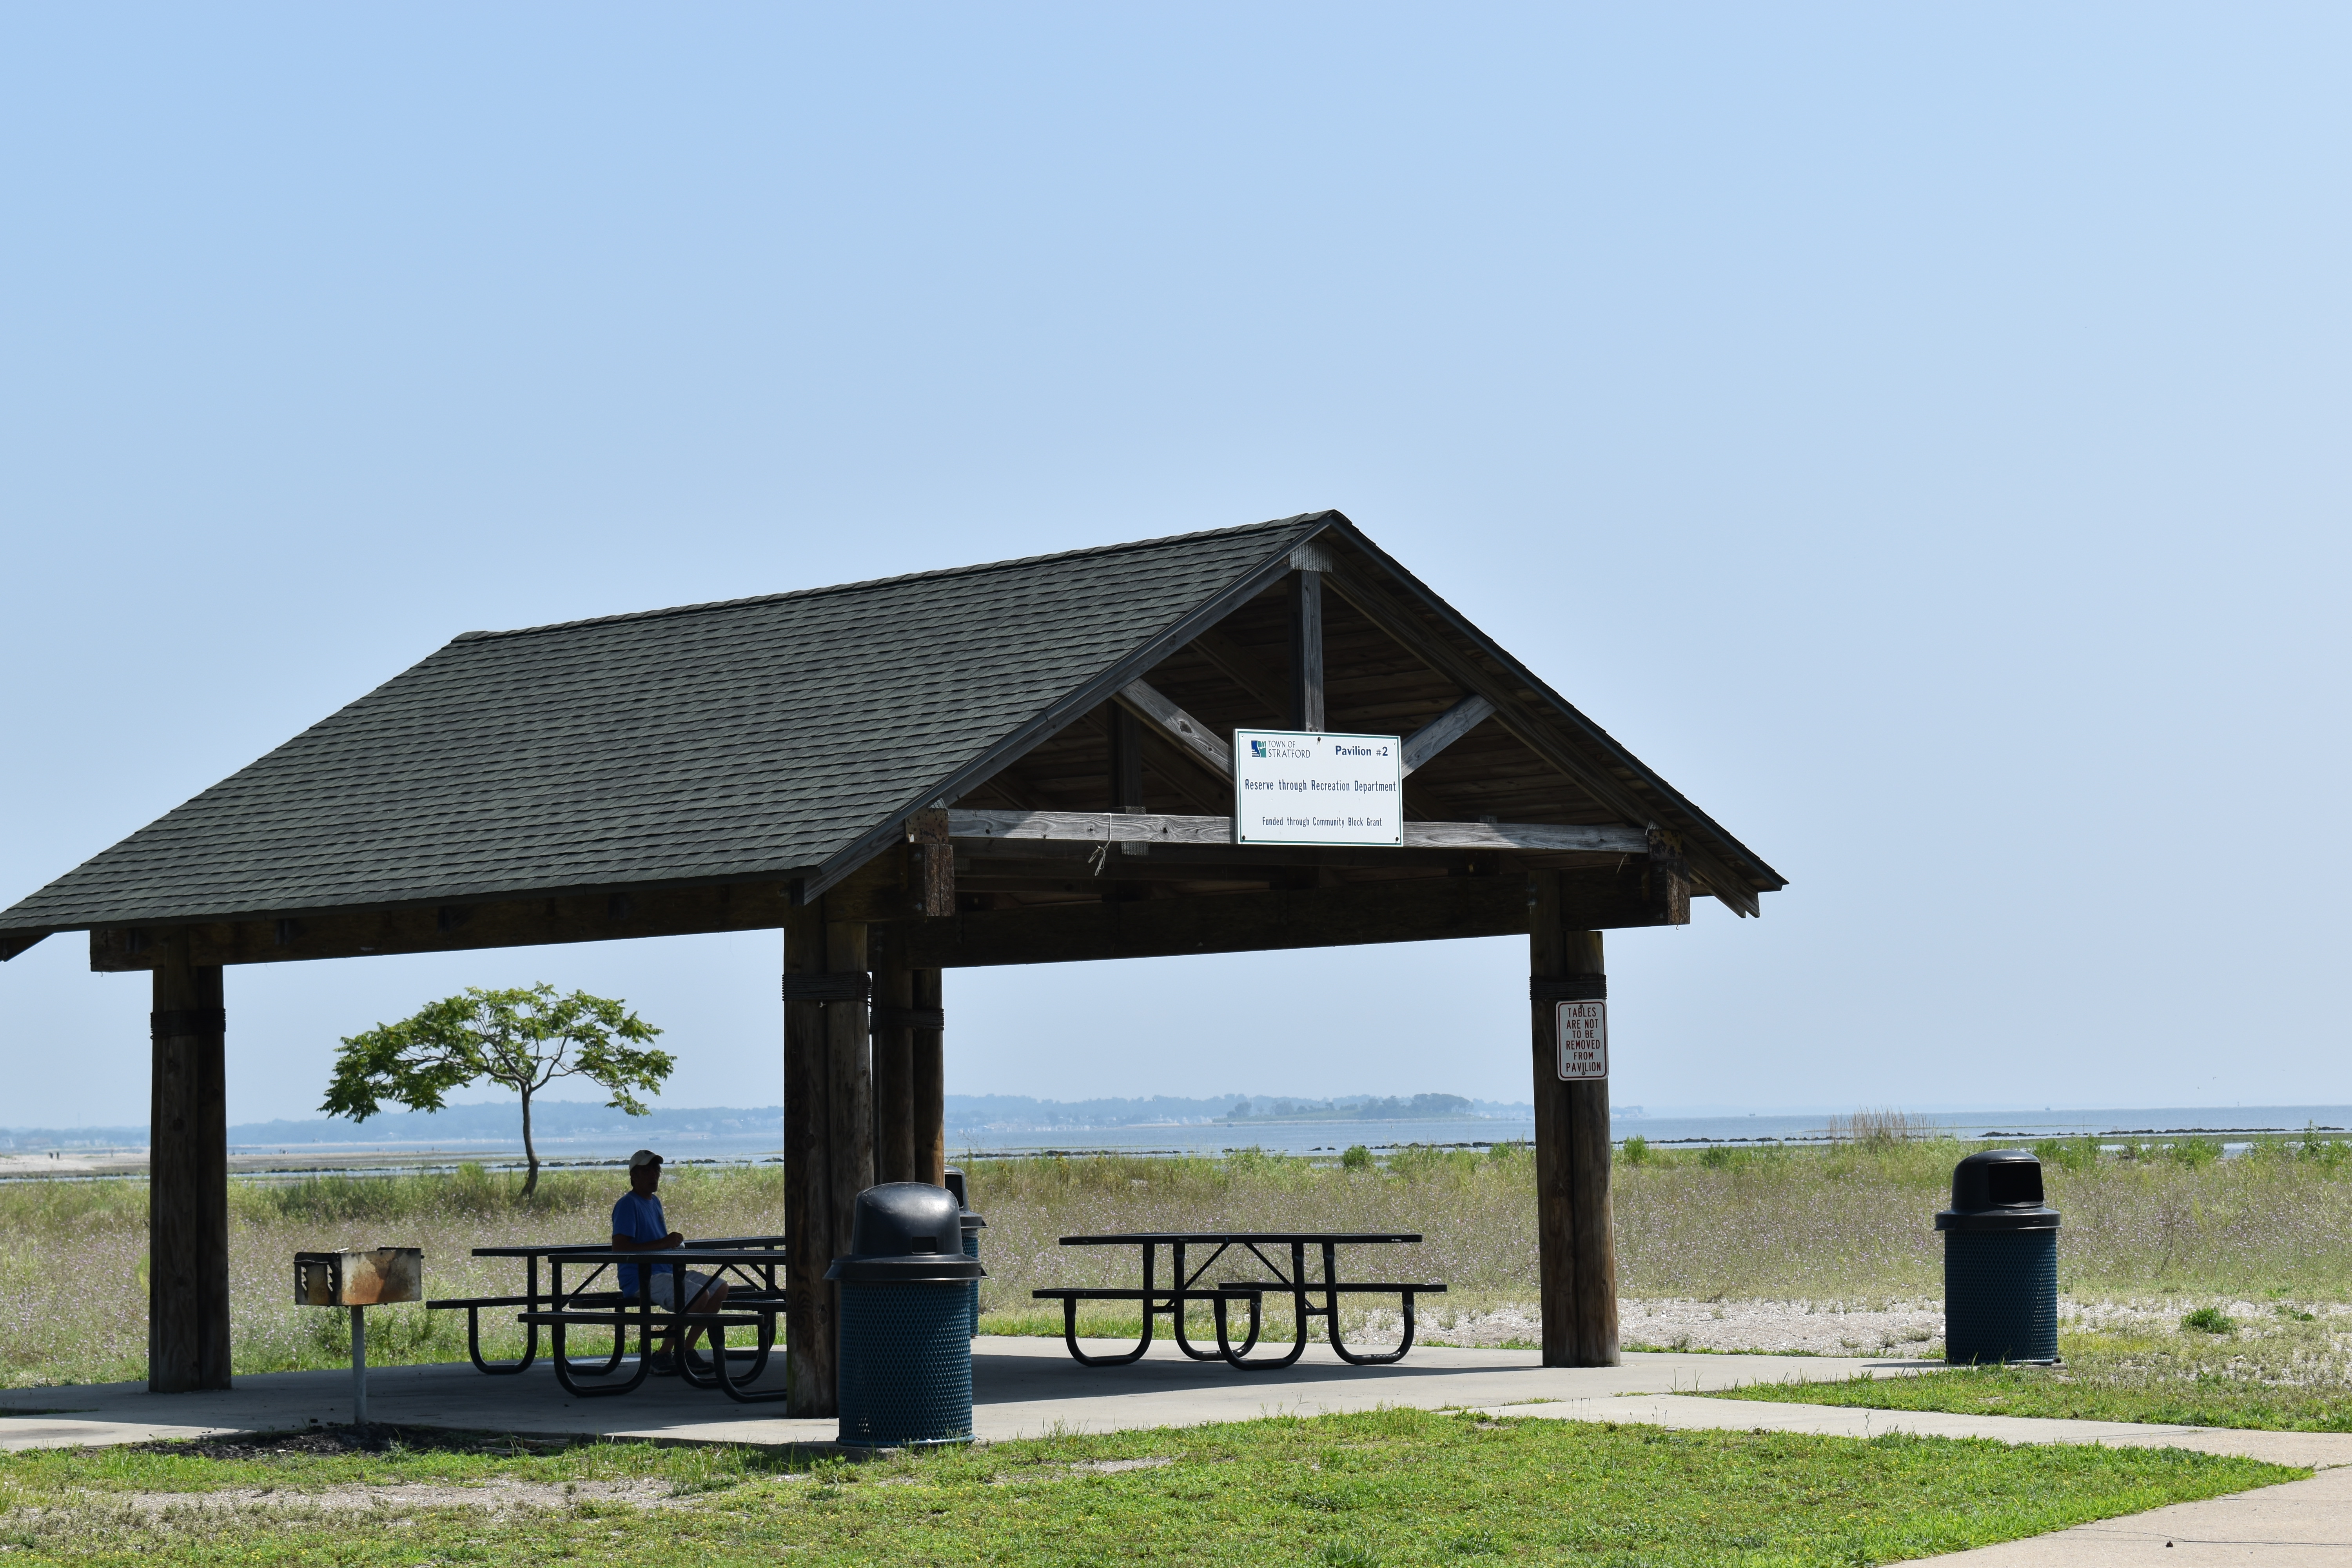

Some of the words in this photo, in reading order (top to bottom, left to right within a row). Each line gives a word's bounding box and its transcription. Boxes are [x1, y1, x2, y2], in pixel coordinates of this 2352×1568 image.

[1268, 749, 1310, 758] STRATFORD
[1335, 746, 1371, 756] Pavilion
[1376, 746, 1388, 756] #2
[1245, 779, 1274, 790] Reserve
[1279, 780, 1307, 792] through
[1311, 780, 1349, 791] Recreation
[1355, 780, 1396, 793] Department
[1262, 817, 1283, 826] Funded
[1287, 817, 1309, 827] through
[1313, 817, 1344, 828] Community
[1348, 817, 1363, 826] Block
[1367, 818, 1382, 826] Grant
[1568, 1007, 1596, 1017] TABLES
[1566, 1020, 1581, 1029] ARE
[1585, 1019, 1598, 1028] NOT
[1566, 1040, 1600, 1050] REMOVED
[1574, 1052, 1593, 1060] FROM
[1566, 1062, 1601, 1072] PAVILION
